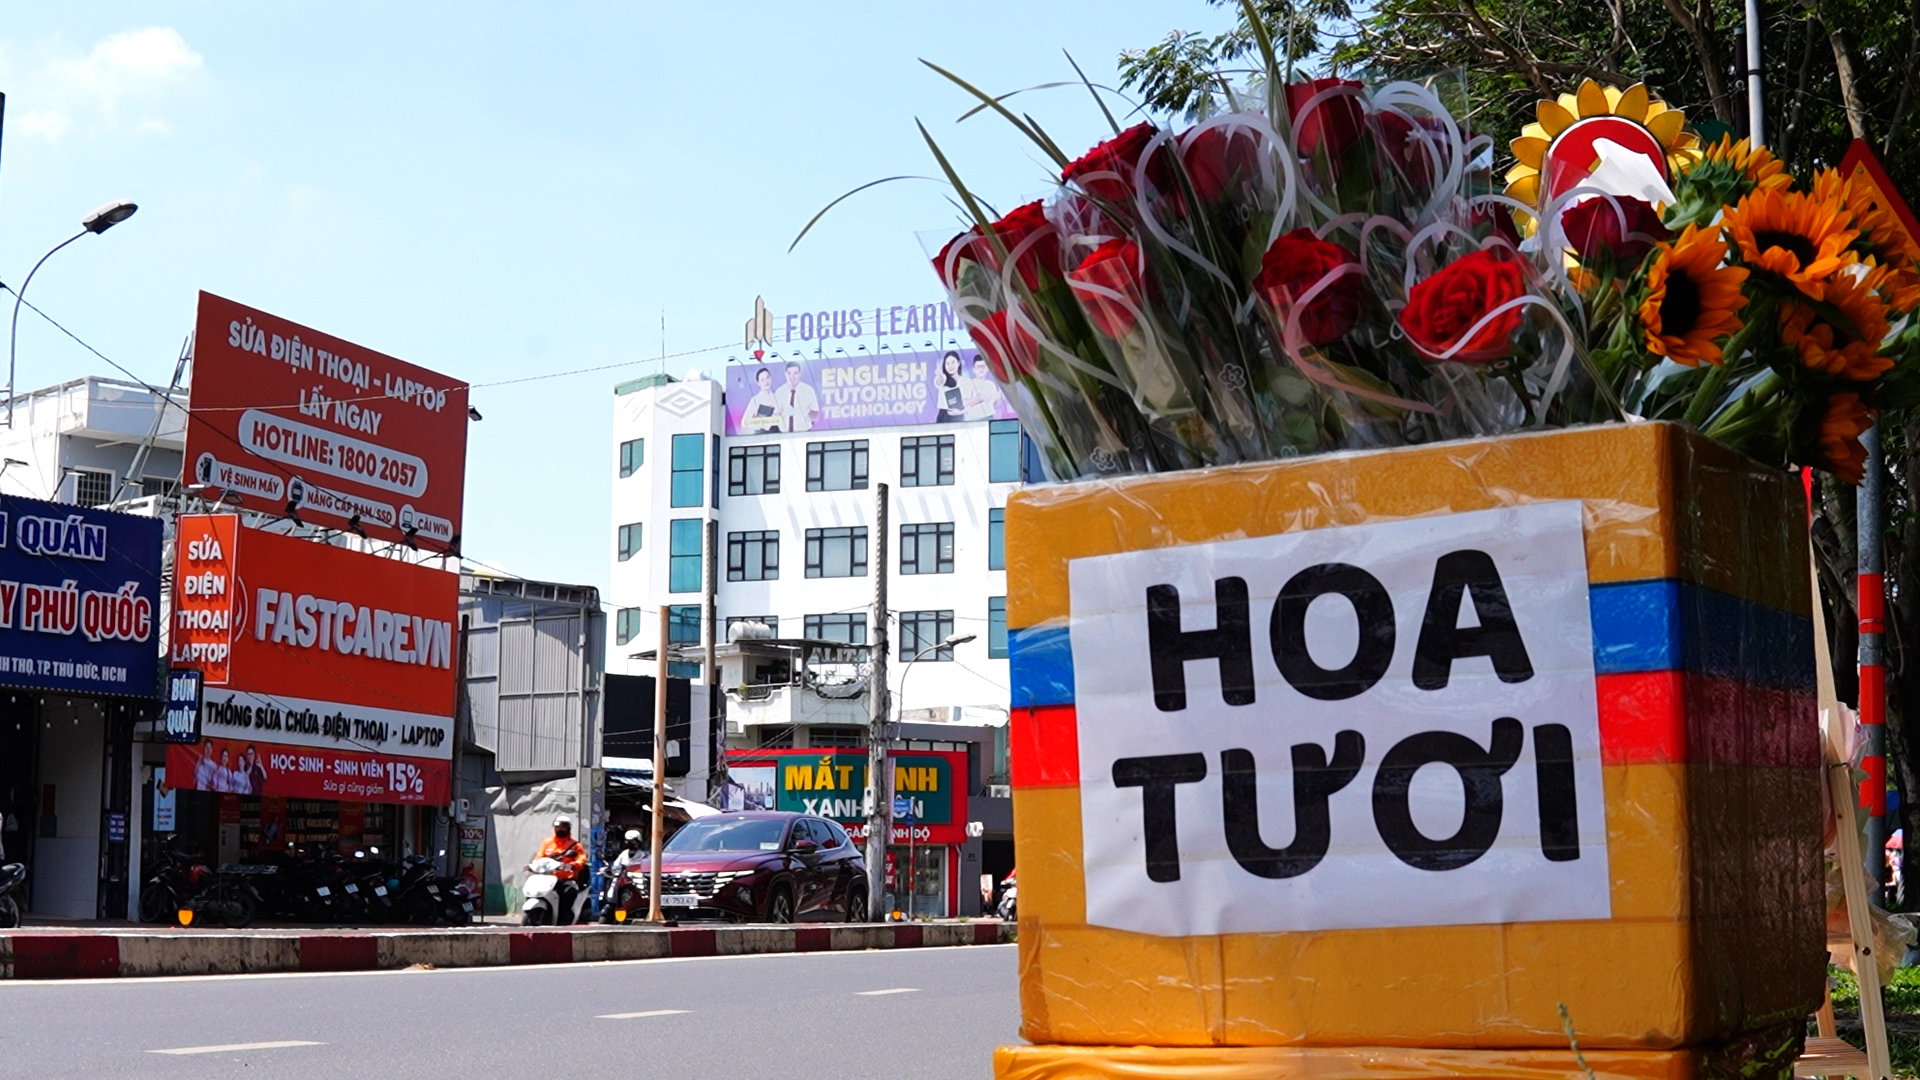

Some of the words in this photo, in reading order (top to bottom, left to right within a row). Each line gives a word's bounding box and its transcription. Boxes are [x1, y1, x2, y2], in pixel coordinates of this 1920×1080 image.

[785, 309, 863, 343] FOCUS
[228, 317, 267, 356] SỬA
[270, 335, 313, 374] ĐIỆN
[317, 349, 370, 394] THOẠI
[384, 373, 447, 413] LAPTOP
[821, 362, 927, 388] ENGLISH
[822, 383, 927, 405] TUTORING
[299, 384, 332, 422] LẤY
[334, 402, 382, 435] NGAY
[823, 400, 926, 420] TECHNOLOGY
[252, 420, 334, 467] HOTLINE:
[337, 444, 377, 477] 1800
[379, 456, 418, 488] 2057
[220, 467, 232, 487] VỆ
[233, 474, 257, 493] SINH
[258, 475, 281, 495] MÁY
[17, 514, 107, 561] QUÁN
[417, 517, 433, 532] CÀI
[433, 522, 449, 537] WIN
[188, 534, 222, 561] SỬA
[184, 571, 225, 599] ĐIỆN
[21, 579, 79, 636] PHÚ
[81, 581, 152, 643] QUỐC
[177, 610, 229, 633] THOẠI
[256, 587, 451, 669] FASTCARE.VN
[1146, 549, 1534, 712] HOA
[171, 643, 228, 663] LAPTOP
[102, 666, 127, 682] HCM
[171, 674, 196, 701] BÚN
[167, 705, 197, 738] QUẬY
[206, 694, 252, 728] THỐNG
[255, 702, 281, 731] SỬA
[285, 708, 319, 734] CHỮA
[322, 711, 350, 743] ĐIỆN
[353, 718, 388, 746] THOẠI
[401, 724, 445, 747] LAPTOP
[270, 754, 295, 774] HỌC
[298, 755, 323, 773] SINH
[333, 760, 358, 776] SINH
[360, 759, 384, 778] VIÊN
[386, 762, 424, 793] 15%
[785, 756, 853, 791] MẮT
[864, 765, 938, 792] NH
[802, 797, 866, 817] XANH
[1111, 717, 1580, 883] TƯƠI
